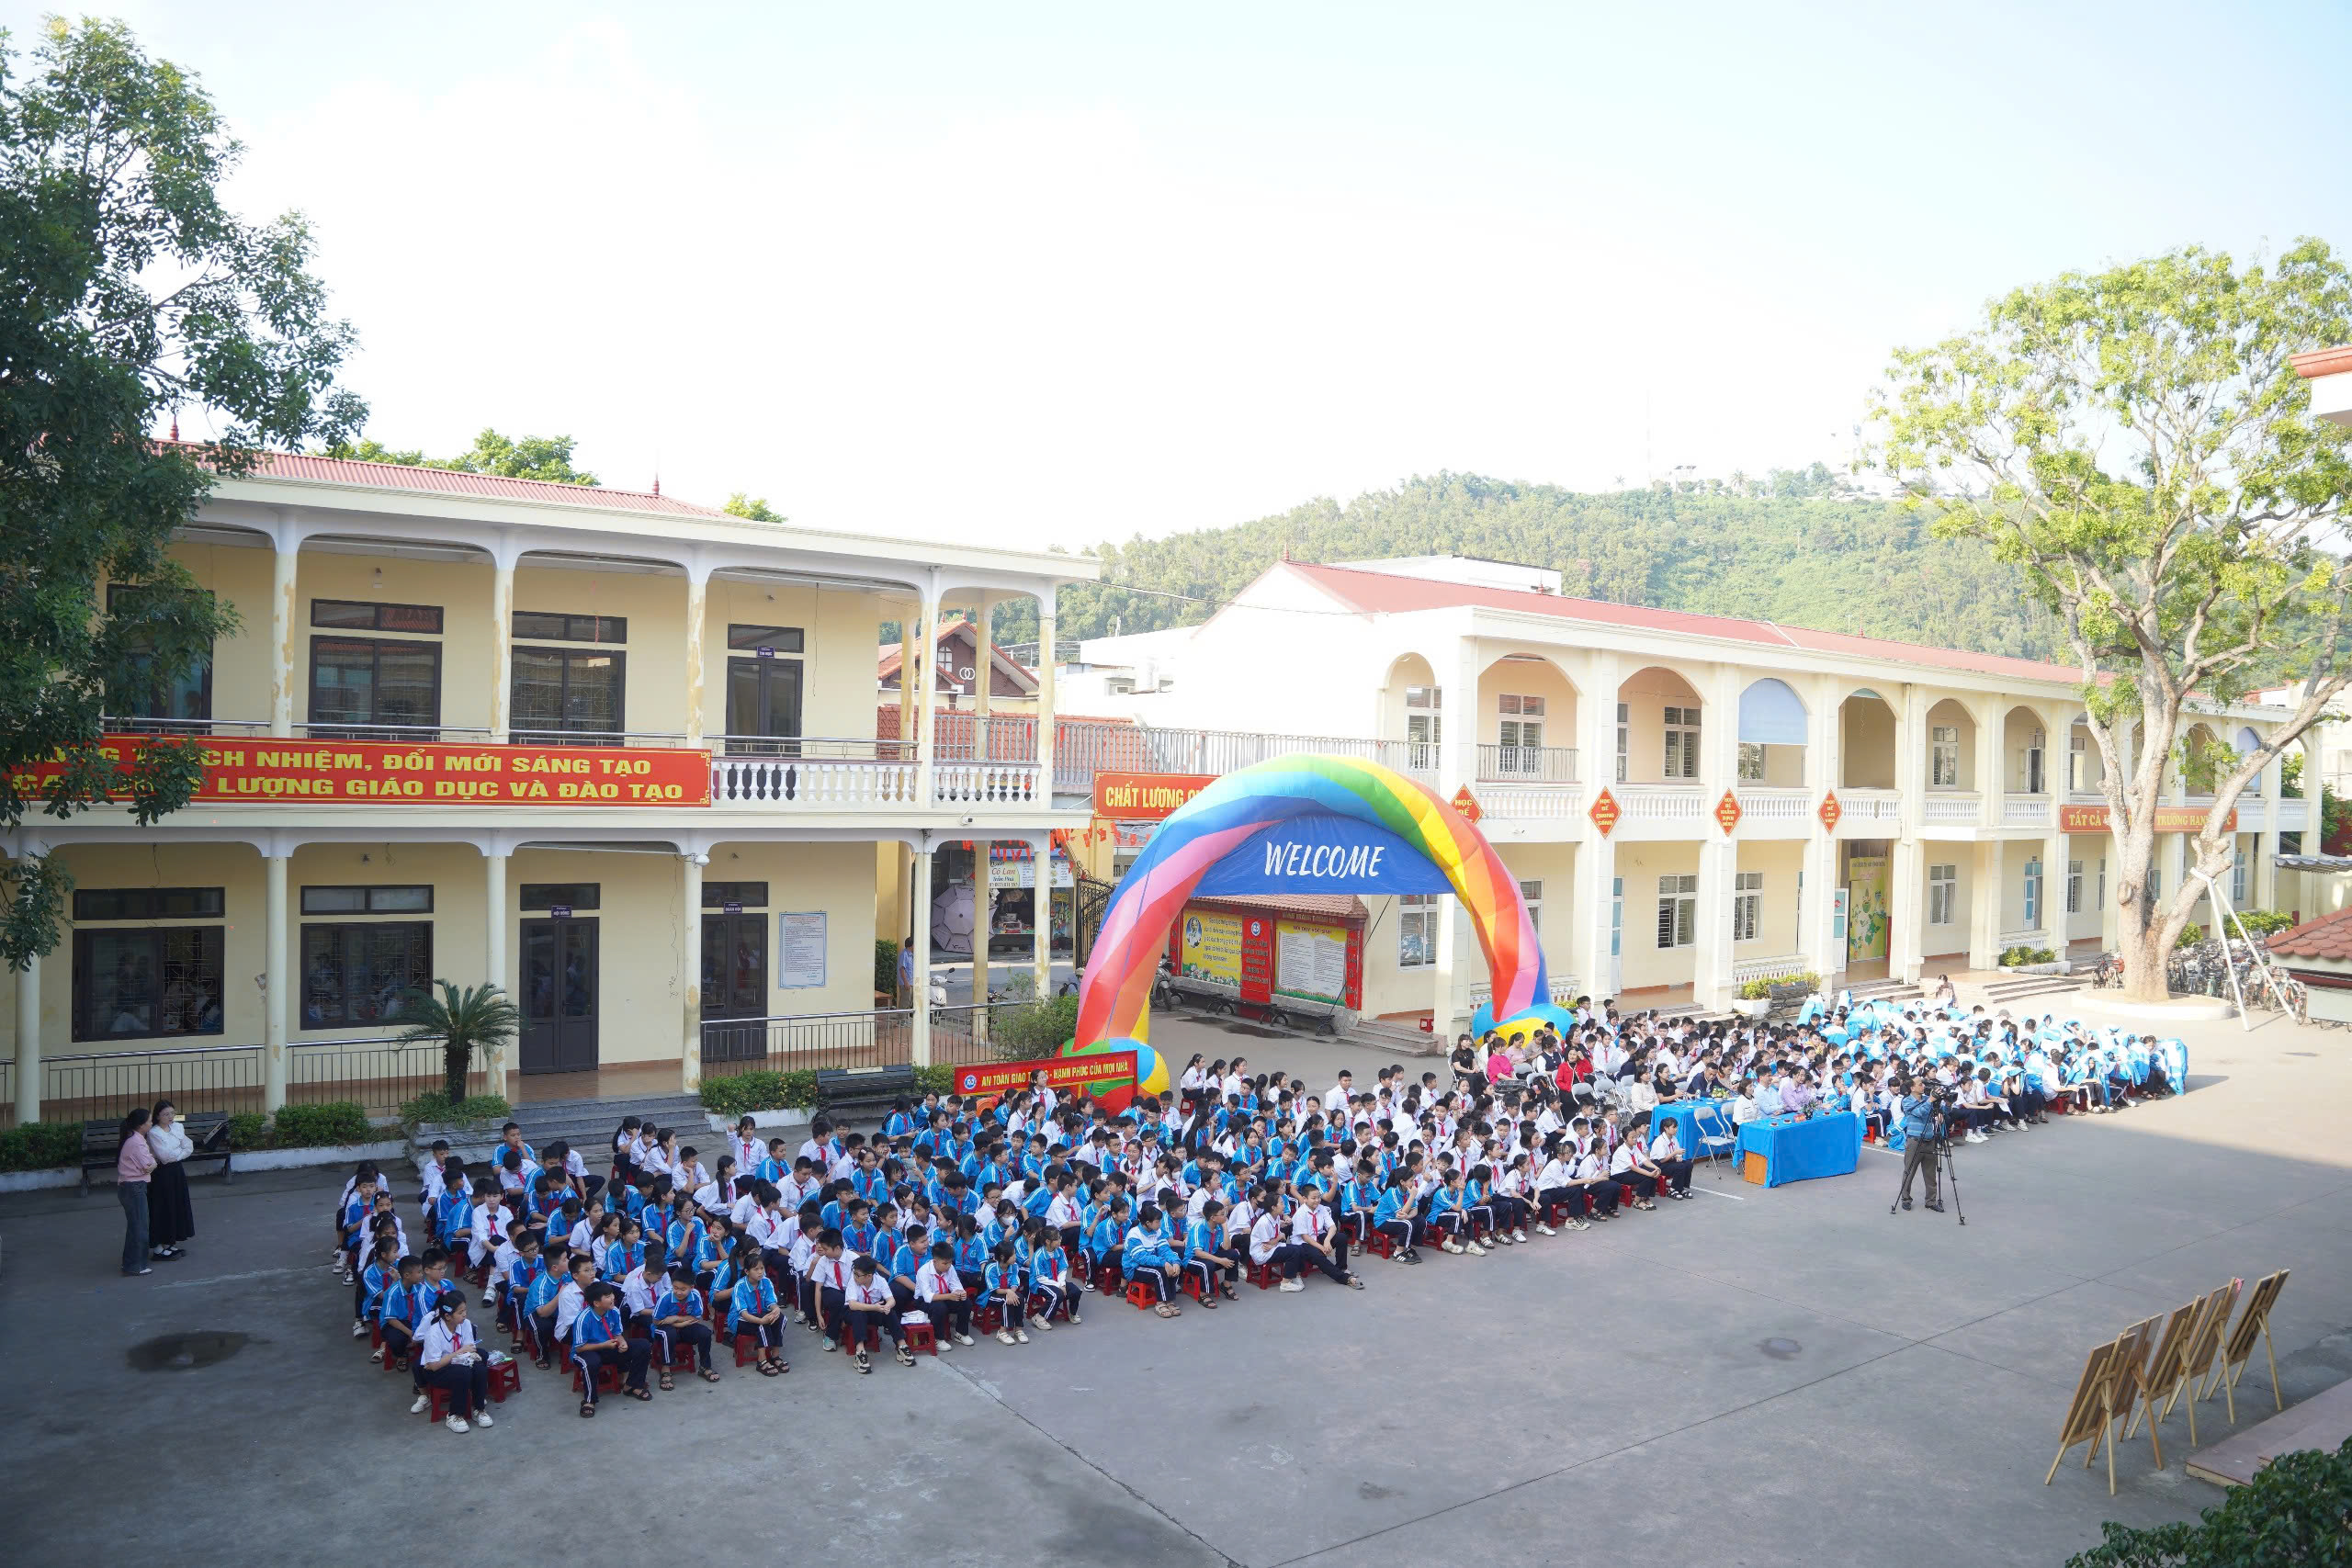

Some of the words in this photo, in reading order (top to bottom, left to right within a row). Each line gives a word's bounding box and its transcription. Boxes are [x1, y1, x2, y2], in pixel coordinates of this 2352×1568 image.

[256, 750, 372, 772] NHIỆM,
[382, 749, 435, 771] ĐỔI
[445, 751, 502, 772] MỚI
[512, 755, 591, 773] SÁNG
[599, 759, 651, 777] TẠO
[218, 776, 334, 798] LƯỢNG
[345, 777, 424, 796] GIÁO
[435, 781, 499, 800] DỤC
[509, 779, 549, 797] VÀ
[558, 780, 619, 798] ĐÀO
[628, 784, 683, 802] TẠO
[1105, 780, 1139, 807] CHẤT
[1142, 786, 1184, 813] LƯỢNG
[1454, 799, 1473, 807] HỌC
[2068, 809, 2087, 826] TẤT
[2089, 809, 2102, 826] CẢ
[2189, 815, 2210, 829] HẠN
[1264, 840, 1385, 879] WELCOME
[981, 1076, 991, 1087] AN
[993, 1073, 1010, 1085] TOÀN
[1011, 1072, 1026, 1084] GIAO
[1053, 1067, 1071, 1080] HẠNH
[1072, 1065, 1089, 1077] PHÚC
[1090, 1062, 1102, 1076] CỦA
[1102, 1063, 1115, 1075] MỌI
[1115, 1060, 1128, 1073] NHÀ
